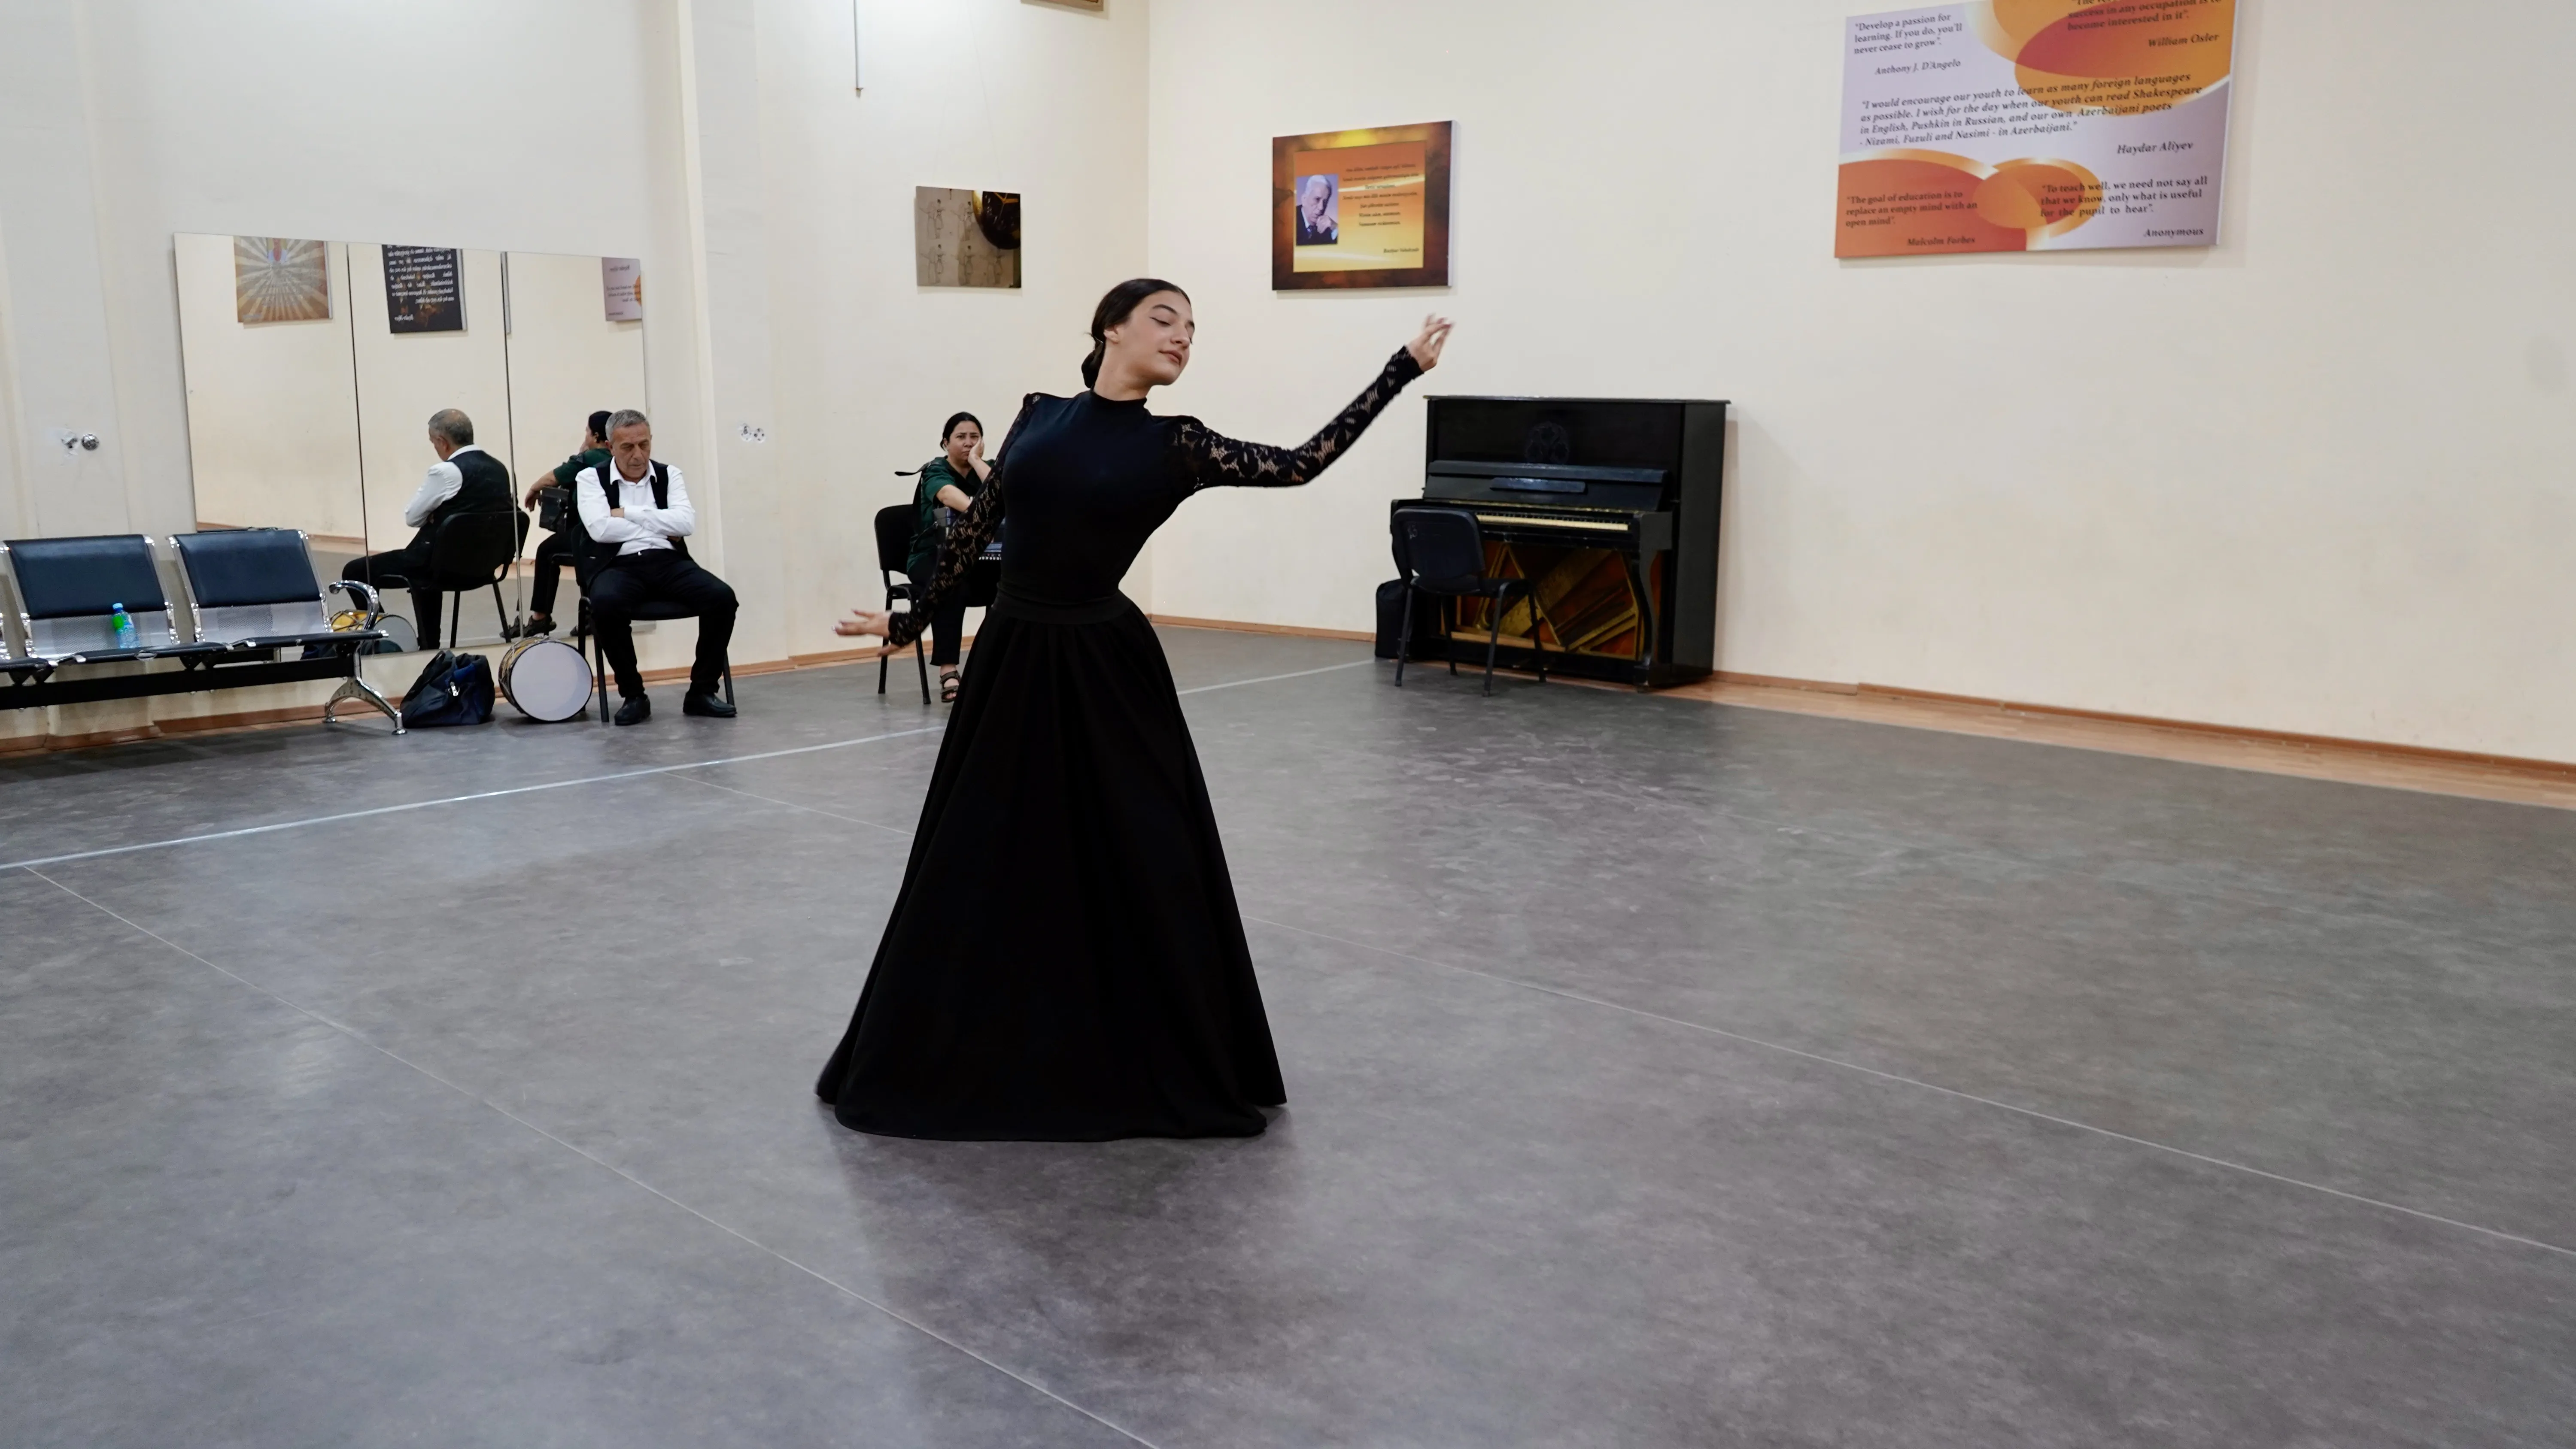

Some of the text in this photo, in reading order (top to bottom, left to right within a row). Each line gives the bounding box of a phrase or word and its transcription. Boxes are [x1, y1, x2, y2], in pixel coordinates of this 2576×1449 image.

[2068, 9, 2104, 18] success
[2119, 6, 2136, 15] any
[1902, 16, 1935, 27] passion
[1938, 13, 1951, 21] for
[2067, 21, 2105, 30] become
[2108, 13, 2159, 26] interested
[2163, 12, 2172, 21] in
[1895, 30, 1902, 38] If
[1904, 30, 1920, 39] you
[2148, 33, 2220, 47] William Osler
[1854, 45, 1877, 54] never
[1879, 43, 1902, 52] cease
[1874, 65, 1911, 75] Anthony
[1871, 98, 1900, 108] would
[1902, 95, 1951, 106] encourage
[1953, 93, 1971, 102] our
[1973, 88, 2001, 102] youth
[2004, 88, 2014, 97] to
[2017, 86, 2043, 96] learn
[2061, 82, 2090, 93] many
[2092, 78, 2131, 91] foreign
[2134, 73, 2190, 85] languages
[1916, 108, 1920, 117] I
[1923, 106, 1944, 116] wish
[1944, 106, 1961, 117] for
[1963, 103, 1980, 113] the
[1981, 102, 1999, 113] day
[2002, 100, 2028, 109] when
[2031, 100, 2049, 108] our
[2050, 93, 2081, 107] youth
[2084, 94, 2102, 103] can
[2106, 91, 2129, 102] read
[2133, 85, 2202, 99] Shakespeare
[1860, 125, 1869, 134] in
[1911, 119, 1950, 130] Pushkin
[1953, 118, 1962, 127] in
[2009, 111, 2028, 121] and
[2051, 110, 2072, 119] own
[2077, 103, 2139, 117] Azerbaijani
[2142, 103, 2172, 114] poets
[1935, 131, 1953, 141] and
[1955, 128, 1990, 139] Nasimi
[1999, 127, 2008, 136] in
[2117, 140, 2193, 155] Haydar Aliyev
[2060, 182, 2085, 192] teach
[2129, 179, 2153, 188] need
[2176, 179, 2192, 188] say
[2194, 176, 2208, 185] all
[1868, 194, 1885, 205] goal
[1887, 192, 1897, 201] of
[1899, 192, 1941, 201] education
[2041, 196, 2060, 205] that
[2108, 193, 2129, 202] only
[2133, 191, 2156, 200] what
[2160, 190, 2168, 199] is
[2170, 189, 2202, 199] useful
[1846, 206, 1876, 217] replace
[1891, 206, 1916, 215] empty
[1920, 202, 1942, 211] mind
[2041, 208, 2054, 217] for
[2059, 208, 2075, 216] the
[2079, 206, 2105, 218] pupil
[2110, 206, 2120, 214] to
[1845, 219, 1866, 228] open
[2144, 227, 2204, 238] Anonymous
